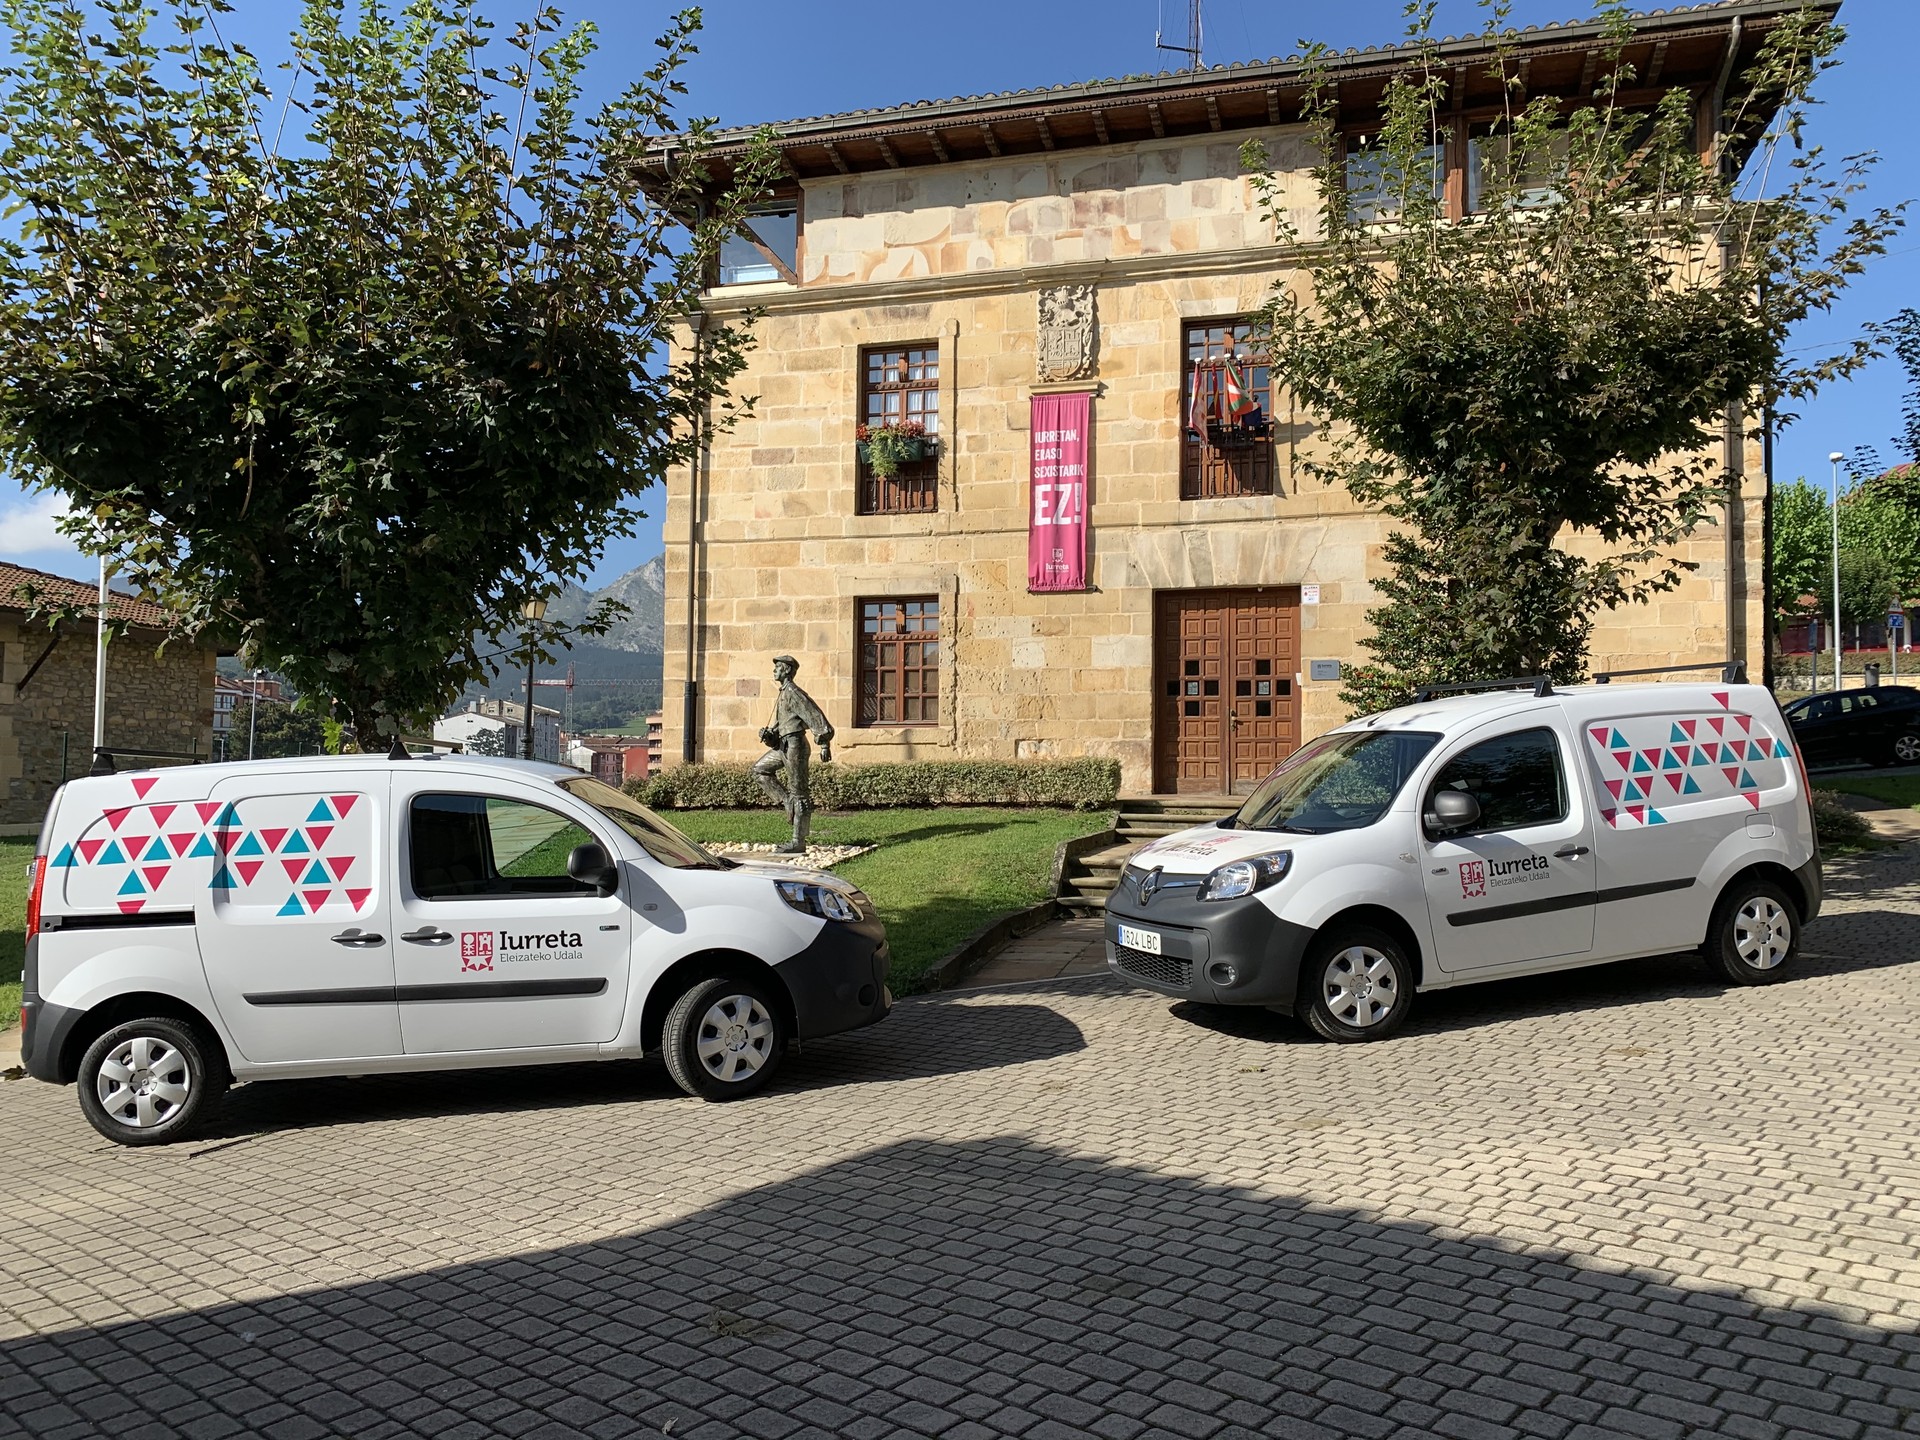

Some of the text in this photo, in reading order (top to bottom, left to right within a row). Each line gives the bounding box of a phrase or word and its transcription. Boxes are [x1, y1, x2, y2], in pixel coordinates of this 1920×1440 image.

[1035, 429, 1080, 443] IURRETAN,
[1035, 448, 1063, 461] ERASO
[1034, 464, 1084, 478] SEXISTARIK
[1035, 483, 1082, 525] EZ!
[1487, 854, 1549, 877] Iurreta
[1490, 871, 1550, 887] Eleizateko Udala
[500, 930, 583, 950] Iurreta
[1123, 929, 1158, 951] 1624 LBC
[500, 951, 583, 963] Eleizateko Udala
